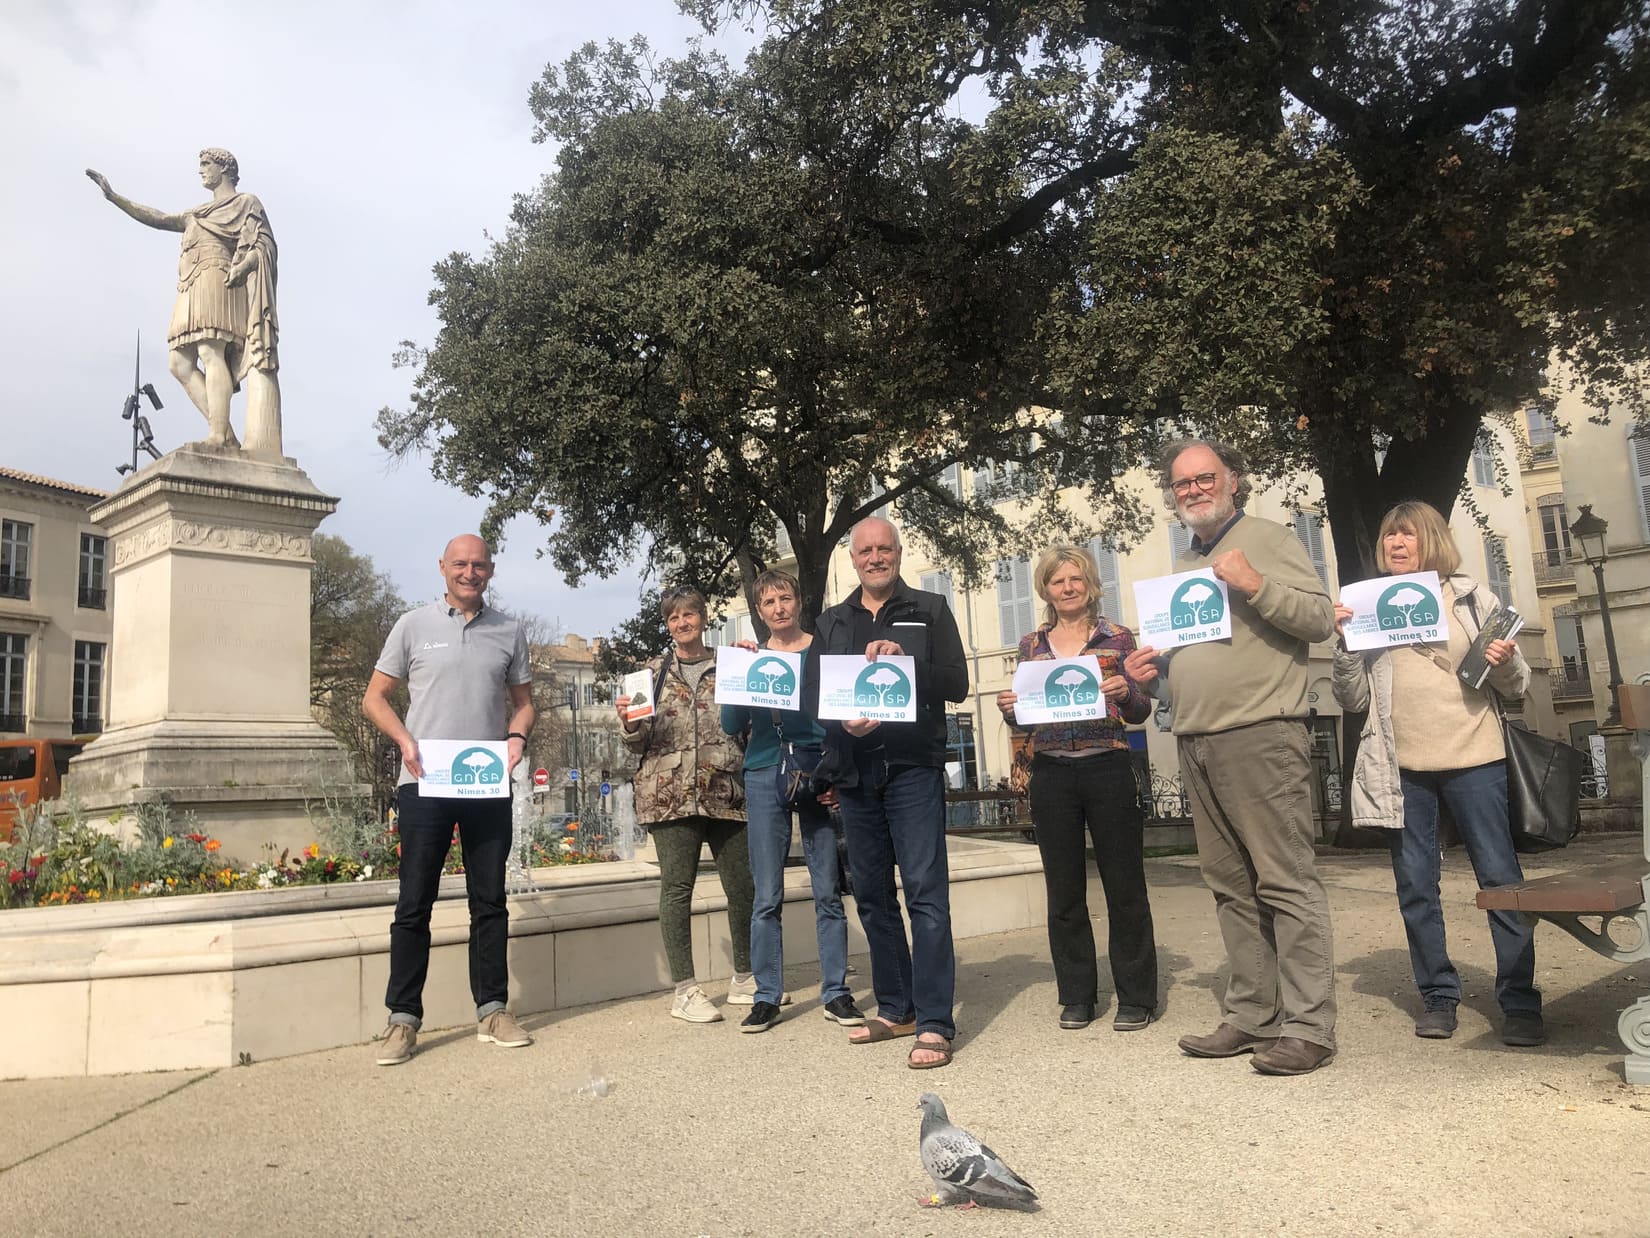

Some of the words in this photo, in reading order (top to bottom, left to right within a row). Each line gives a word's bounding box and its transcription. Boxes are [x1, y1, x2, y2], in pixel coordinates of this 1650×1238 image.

[1210, 627, 1221, 636] 30
[1426, 629, 1437, 638] 30
[1086, 708, 1096, 716] 30
